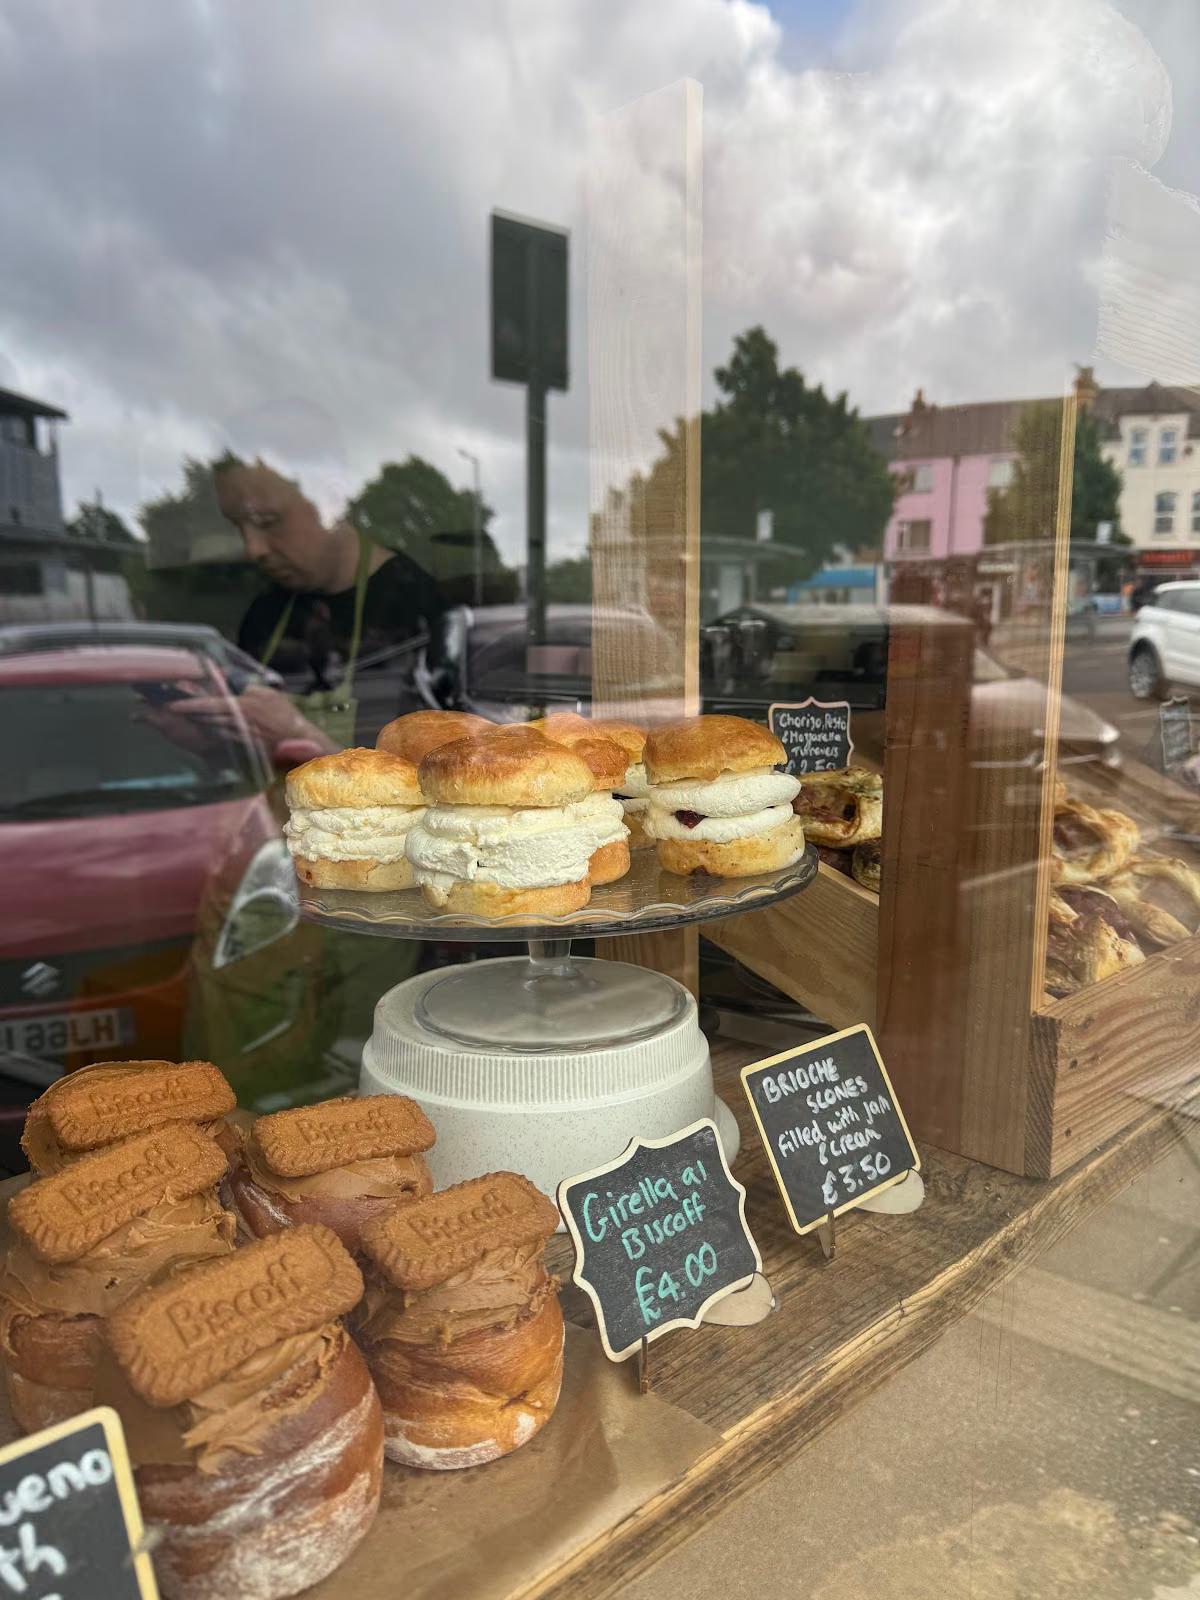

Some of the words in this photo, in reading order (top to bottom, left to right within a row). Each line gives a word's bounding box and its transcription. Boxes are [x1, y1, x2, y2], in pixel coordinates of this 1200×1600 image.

[762, 1057, 840, 1103] BRIOCHE
[806, 1075, 868, 1113] SCONES
[827, 1106, 860, 1134] with
[821, 1152, 891, 1205] £3.50
[583, 1177, 679, 1242] Girella
[635, 1242, 718, 1325] £4.00
